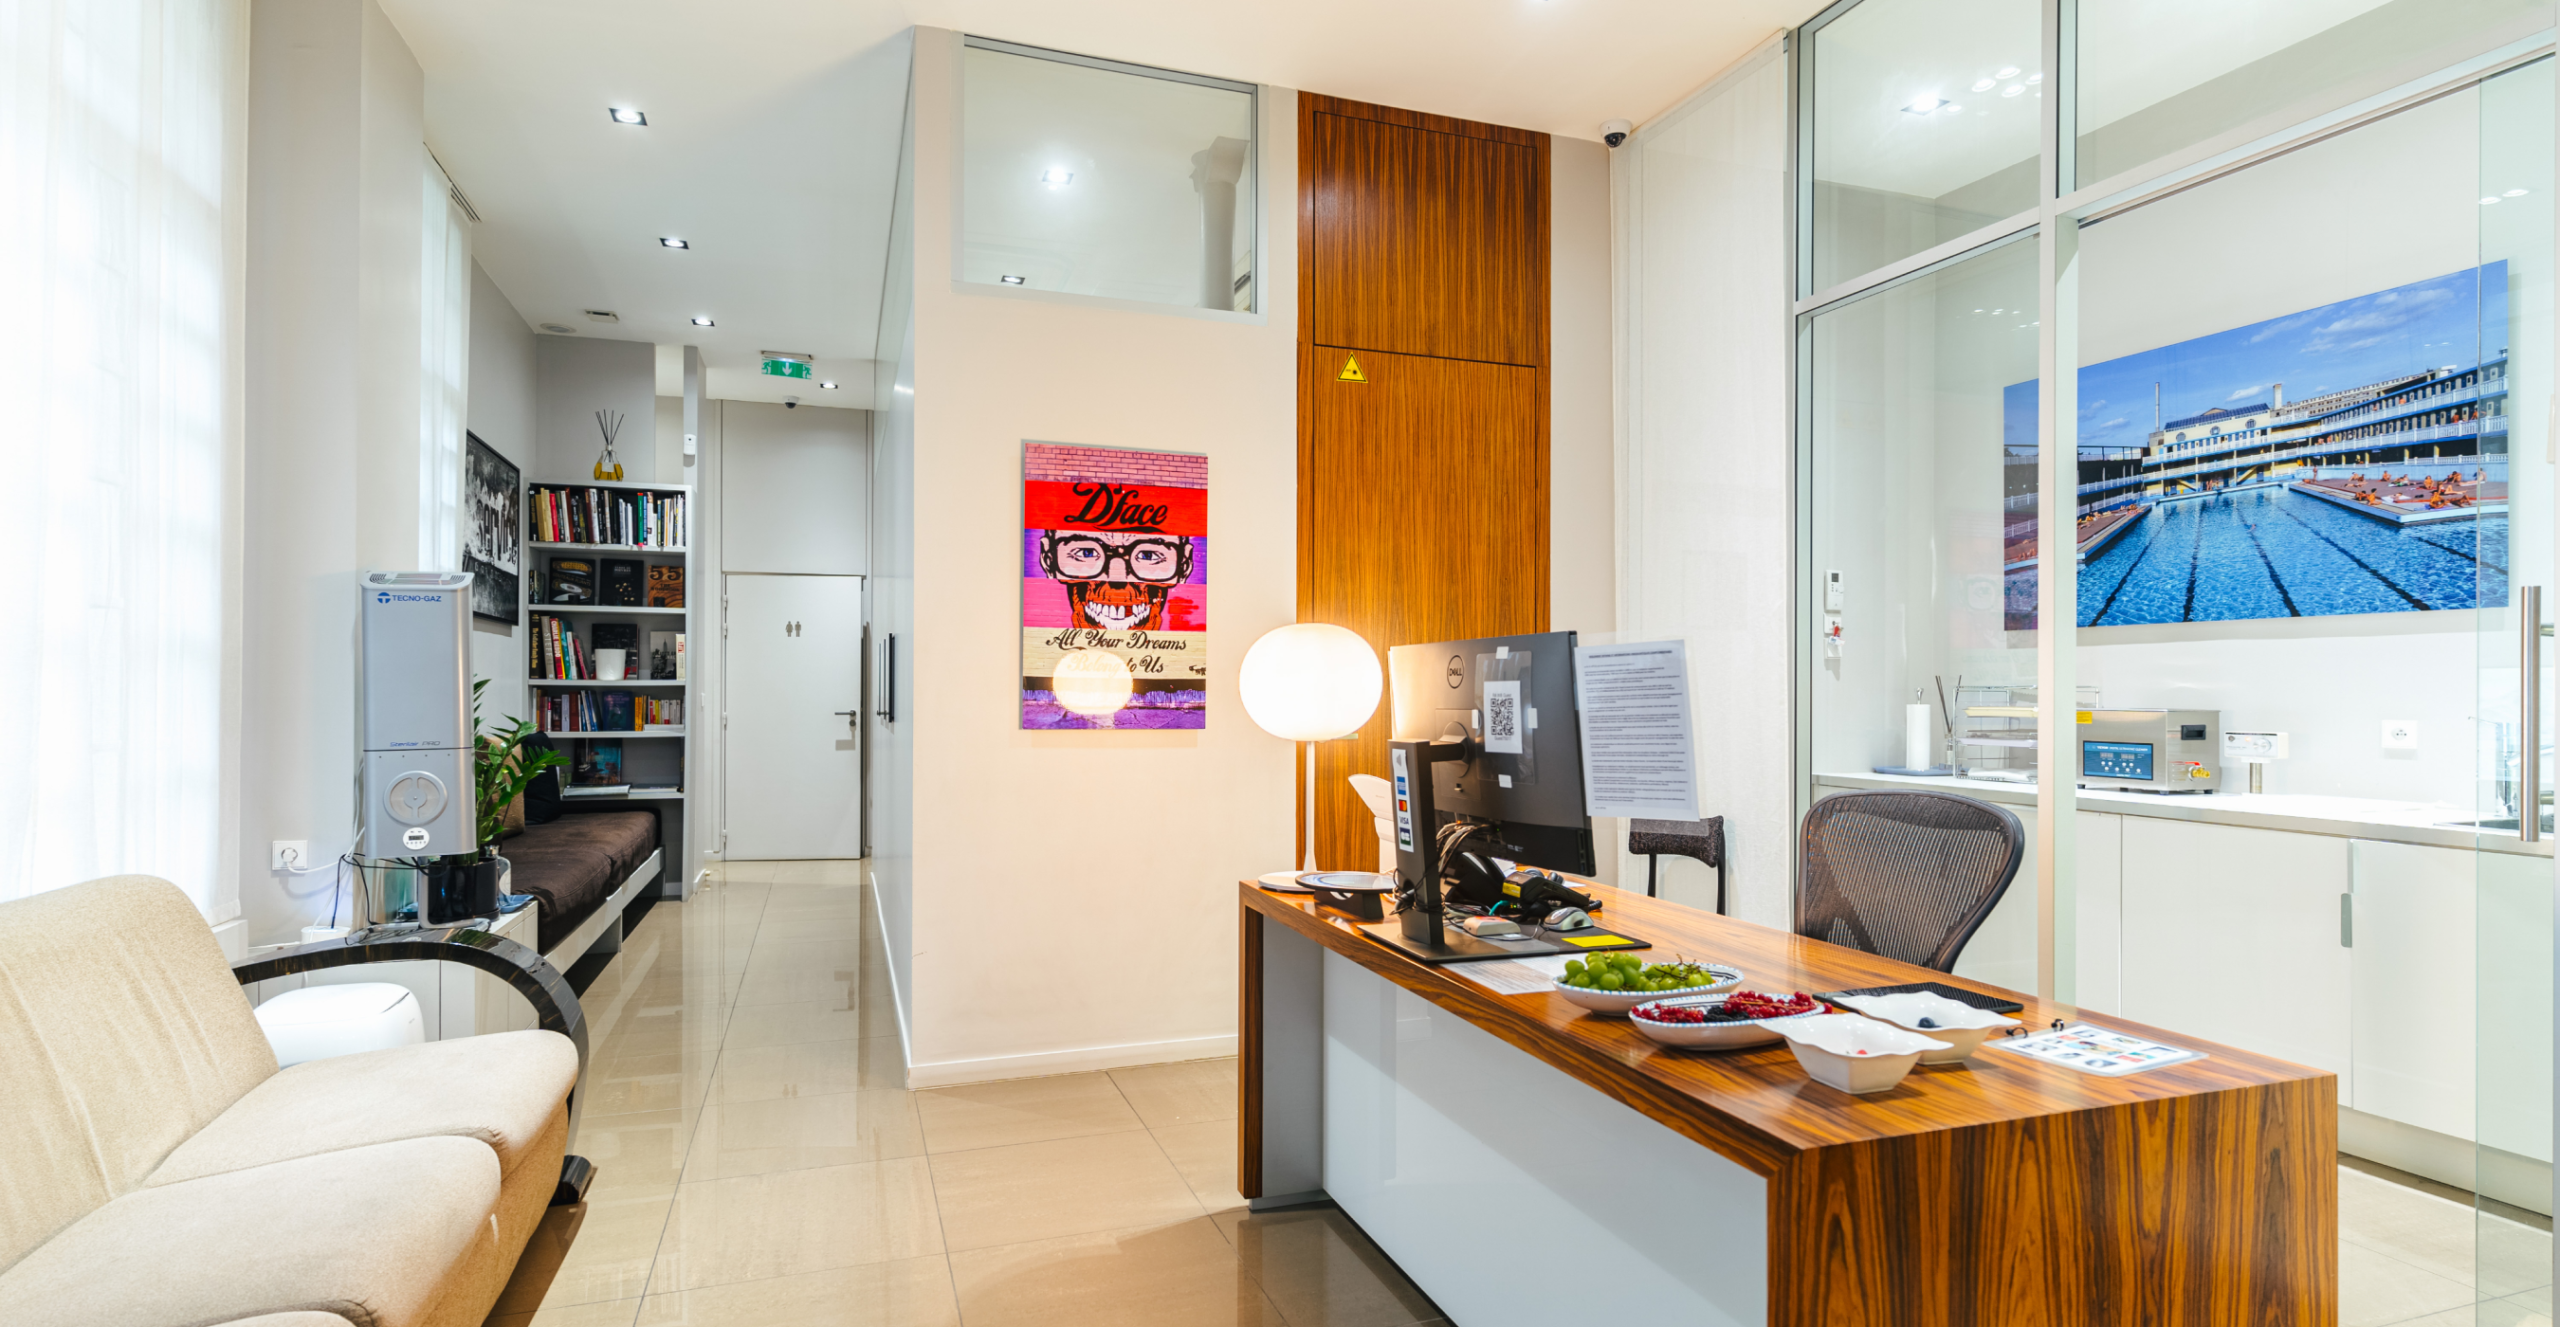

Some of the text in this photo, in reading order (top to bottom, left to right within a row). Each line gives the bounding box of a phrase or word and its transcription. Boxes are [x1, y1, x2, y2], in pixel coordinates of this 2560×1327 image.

[392, 595, 442, 603] TECNO-GAZ
[1046, 627, 1187, 651] All Your Dreams
[1140, 655, 1165, 674] Us
[1449, 668, 1463, 677] DELL
[1398, 815, 1410, 826] VISA
